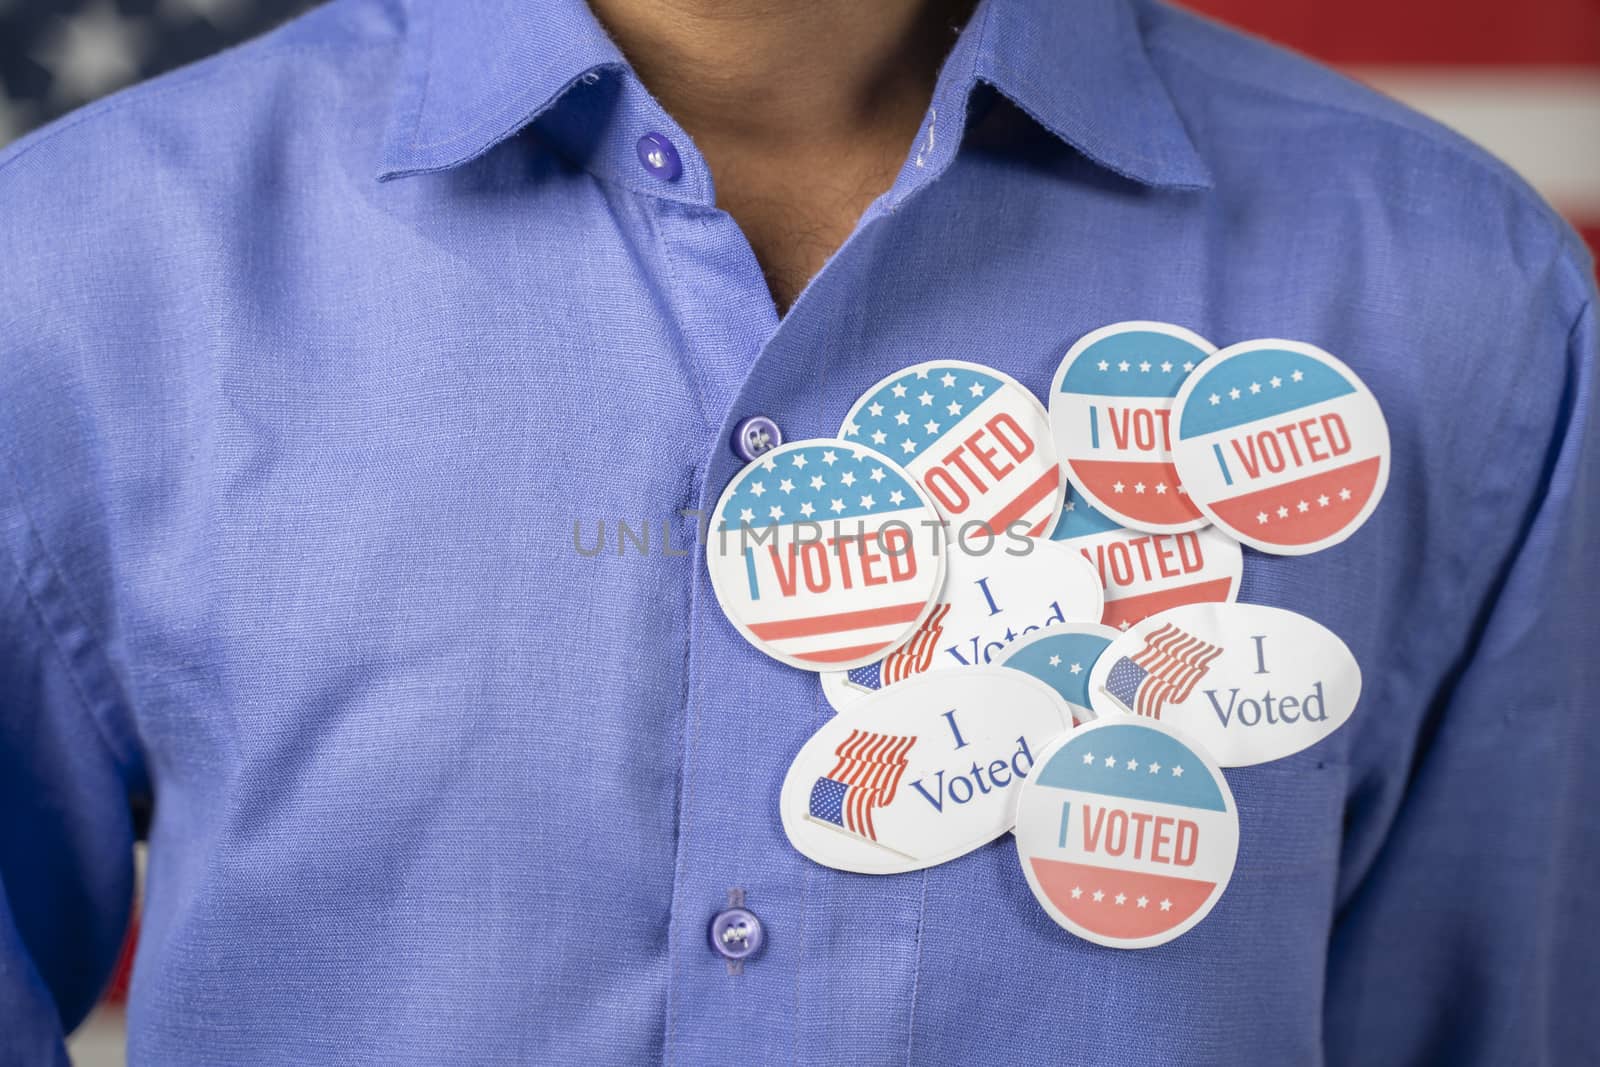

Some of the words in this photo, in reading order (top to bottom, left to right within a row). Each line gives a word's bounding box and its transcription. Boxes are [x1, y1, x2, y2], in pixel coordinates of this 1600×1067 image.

[1089, 406, 1099, 448] I
[1108, 407, 1171, 451] VOT
[1212, 443, 1234, 486] I
[1231, 412, 1353, 480] VOTED
[920, 412, 1035, 516] OTED
[745, 547, 760, 600] I
[768, 528, 918, 598] VOTED
[974, 576, 1003, 616] I
[1250, 635, 1271, 675] I
[940, 708, 969, 751] I
[1203, 681, 1329, 729] Voted
[908, 735, 1035, 814] Voted
[1058, 801, 1071, 849] I
[1082, 804, 1200, 867] VOTED
